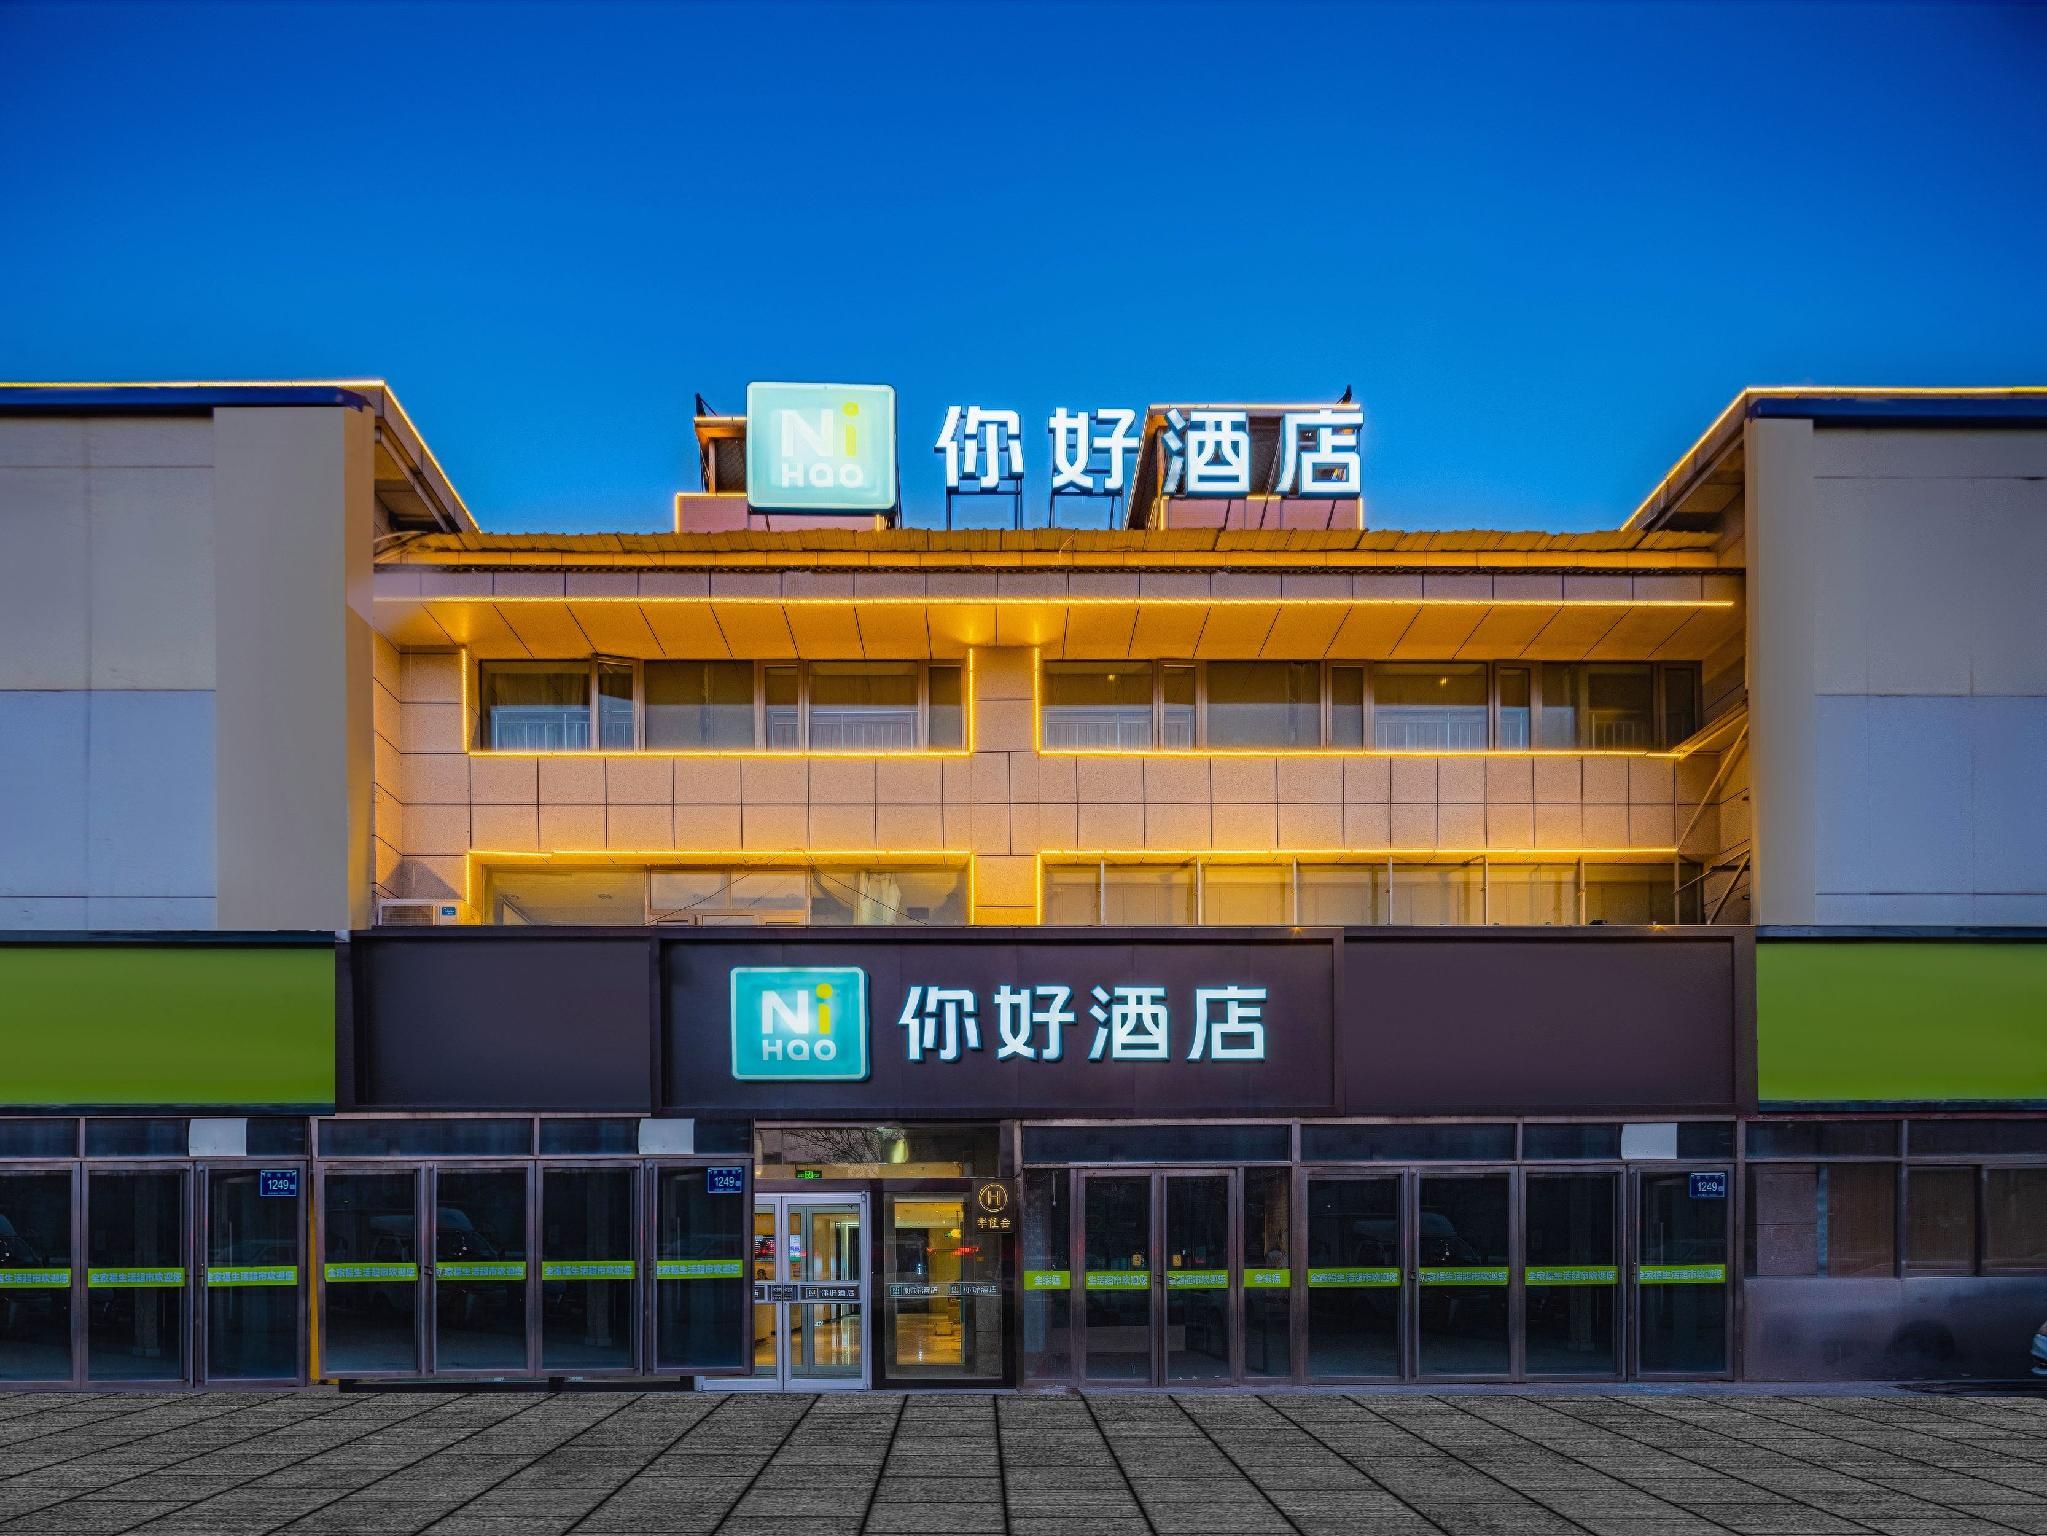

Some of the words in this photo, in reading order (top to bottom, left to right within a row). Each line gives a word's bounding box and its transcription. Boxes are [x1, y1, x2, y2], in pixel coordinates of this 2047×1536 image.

[781, 400, 860, 457] Ni
[935, 404, 1365, 498] 你好酒店
[761, 983, 833, 1035] Ni
[899, 985, 1268, 1063] 你好酒店
[267, 1179, 289, 1190] 1249
[714, 1176, 735, 1187] 1249
[1697, 1181, 1718, 1192] 1249
